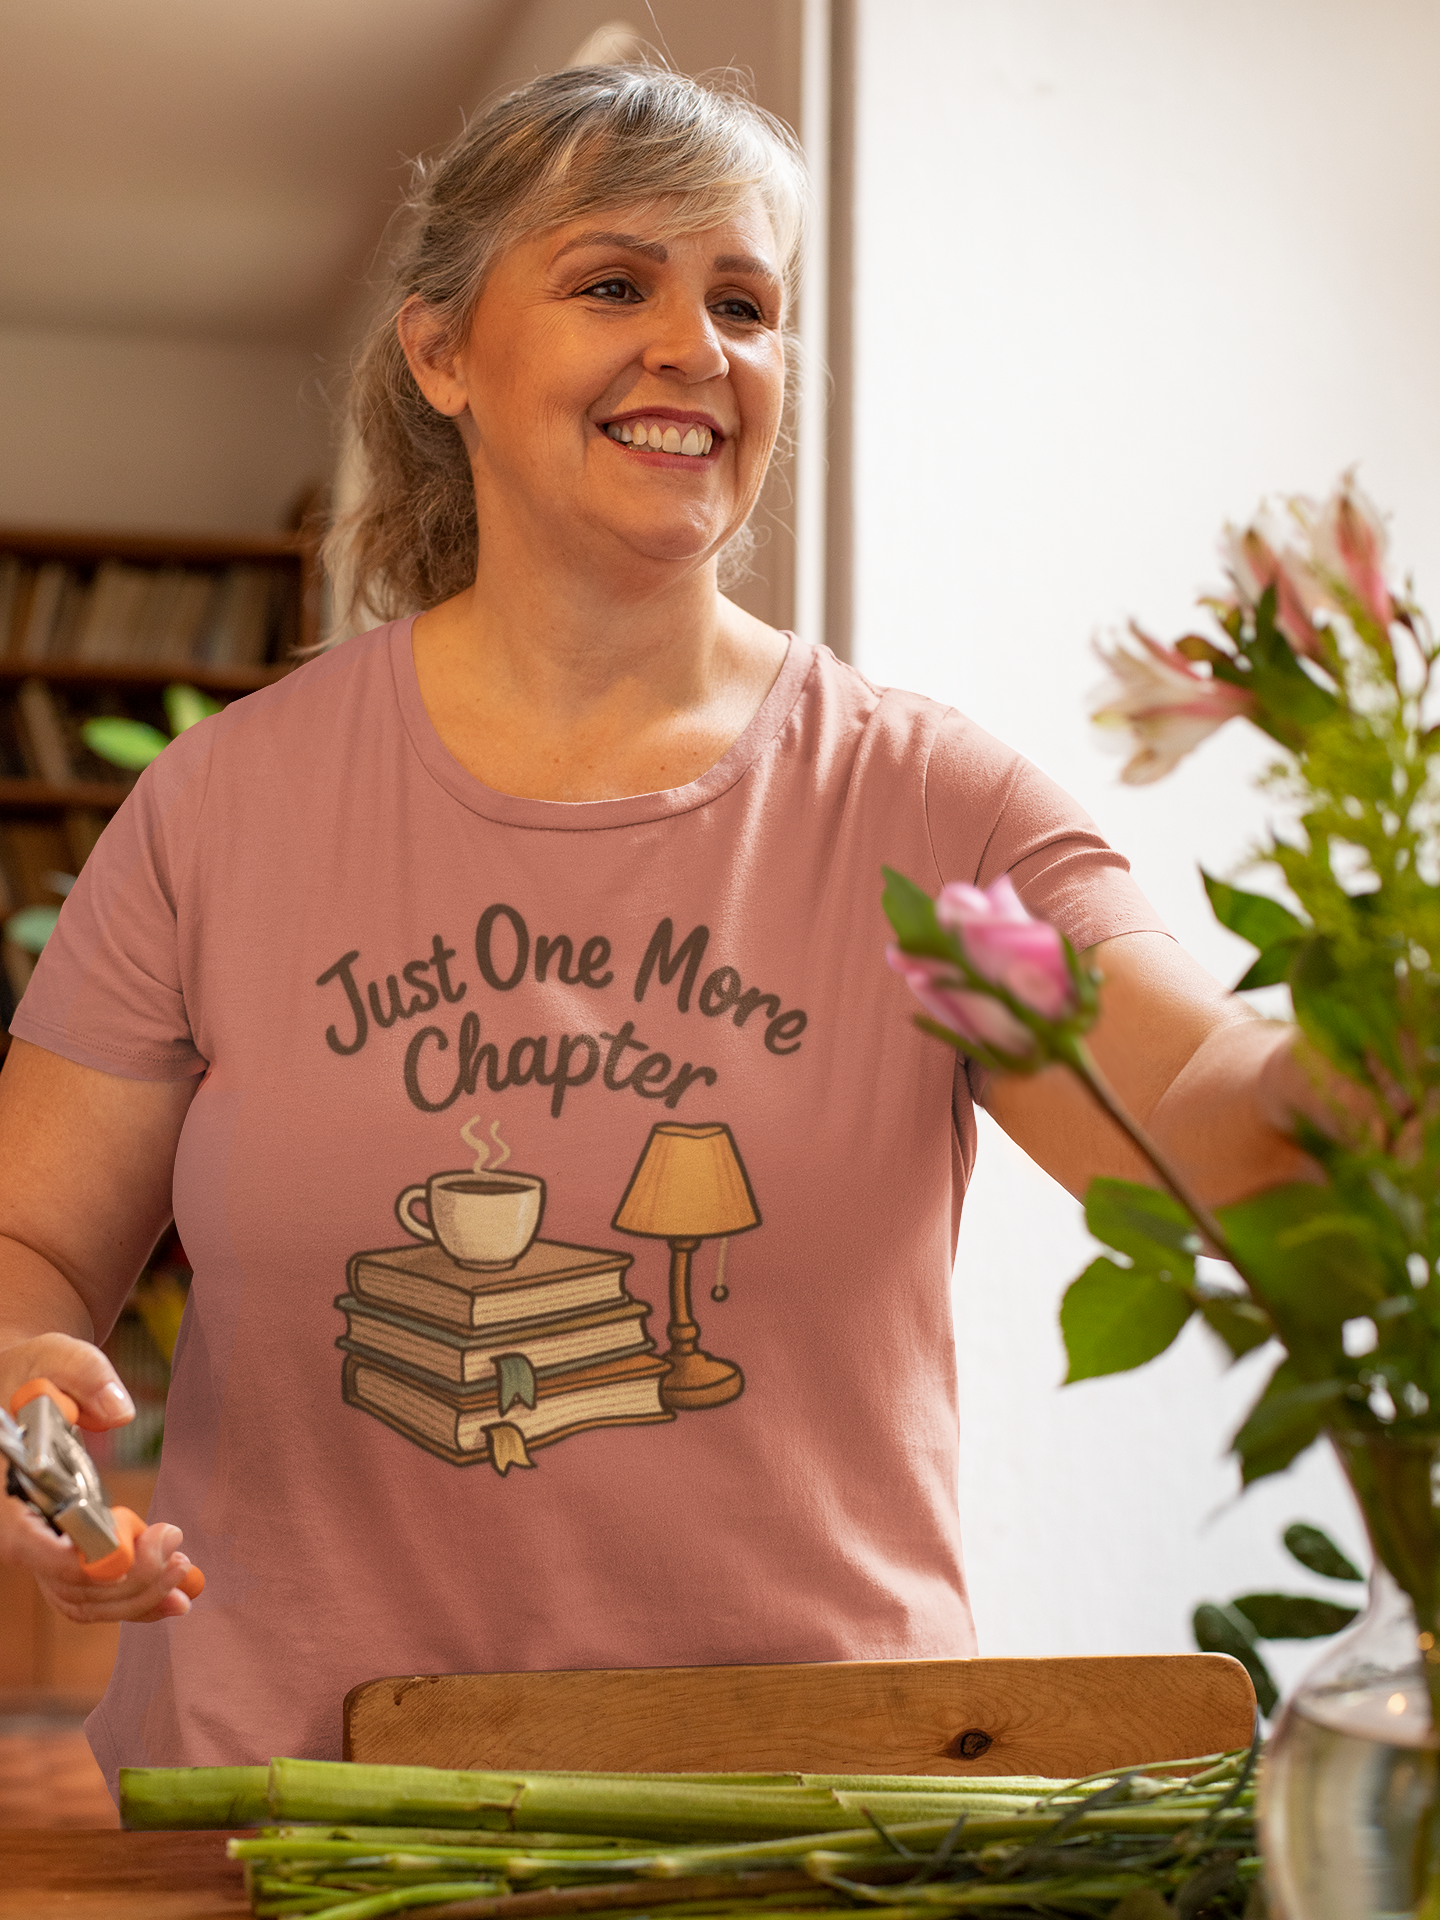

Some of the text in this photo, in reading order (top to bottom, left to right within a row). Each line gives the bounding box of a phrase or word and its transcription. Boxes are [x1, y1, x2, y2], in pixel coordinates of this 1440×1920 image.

[316, 903, 808, 1056] Just One More
[404, 1011, 718, 1119] Chapter
